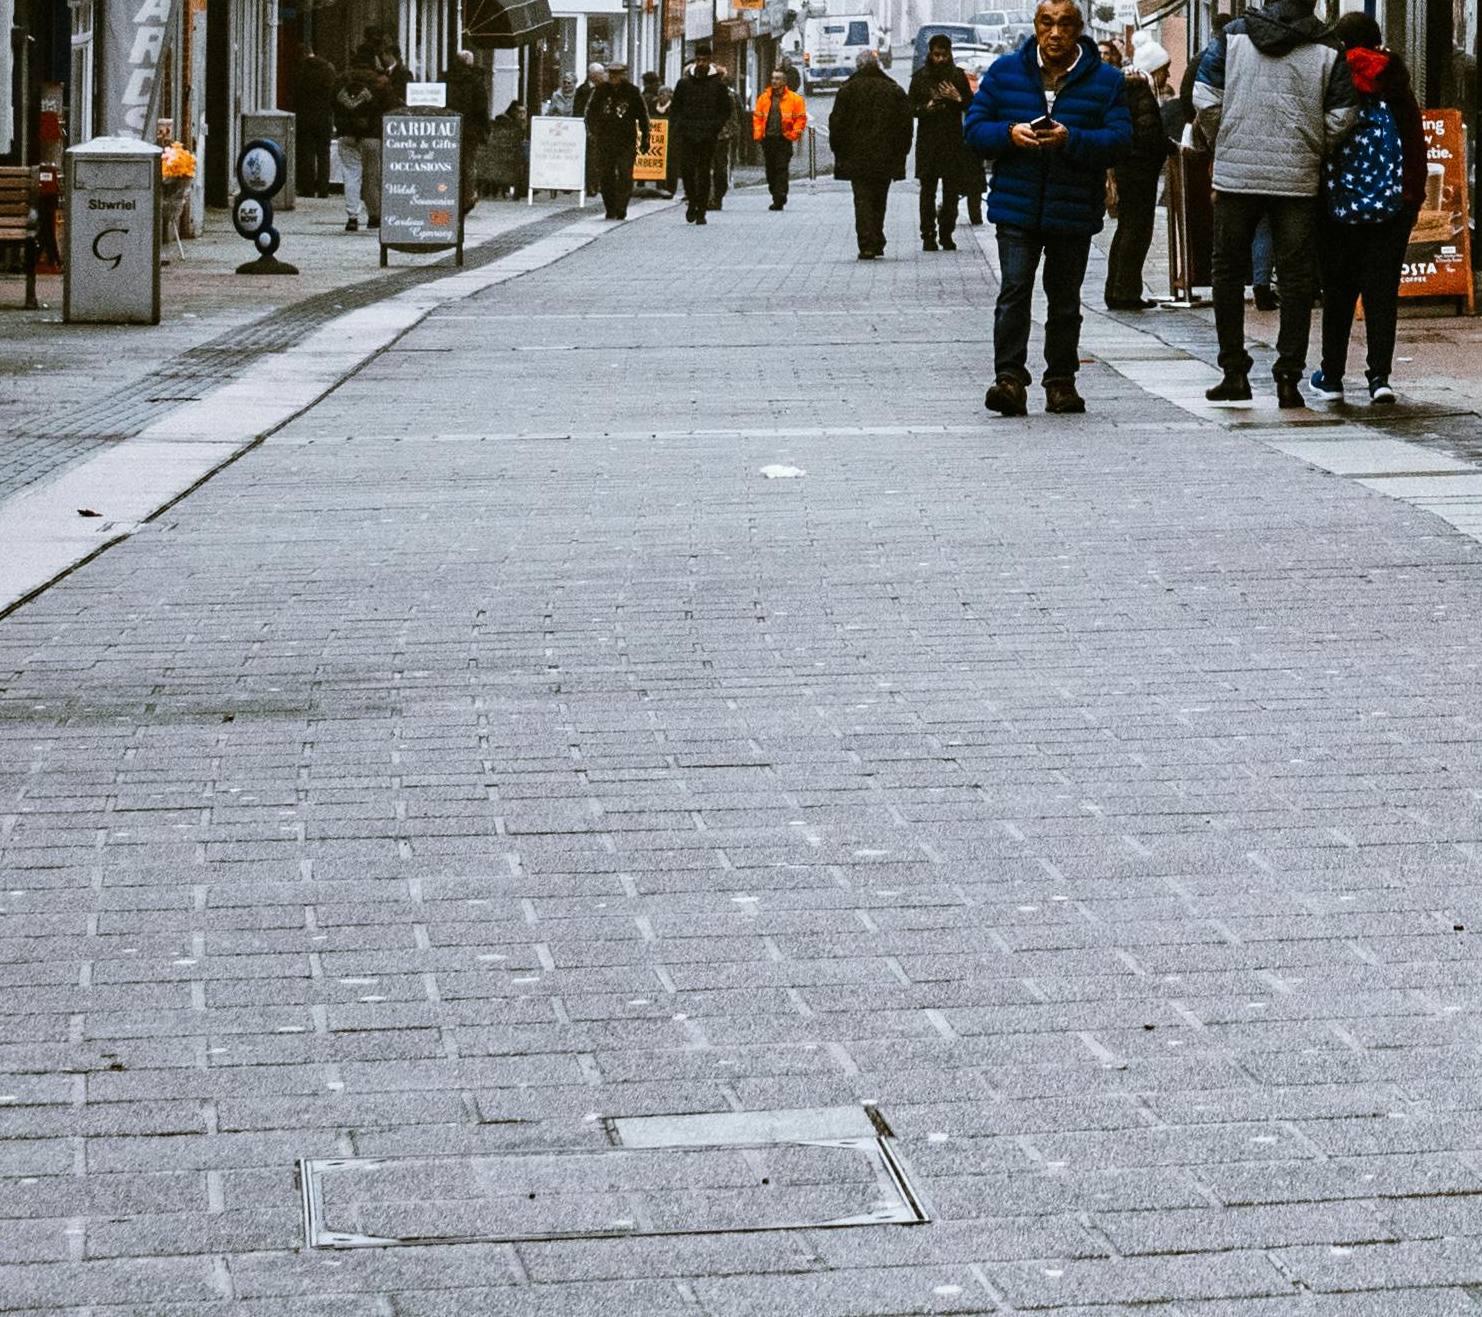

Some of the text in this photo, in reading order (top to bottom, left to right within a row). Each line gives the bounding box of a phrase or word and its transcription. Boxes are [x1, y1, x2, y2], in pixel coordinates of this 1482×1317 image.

[386, 121, 457, 137] CARDIAU
[385, 139, 457, 150] Cards & Gifts
[389, 162, 453, 172] OCCASIONS
[87, 198, 137, 211] Sbwriel
[1400, 262, 1438, 277] OSTA
